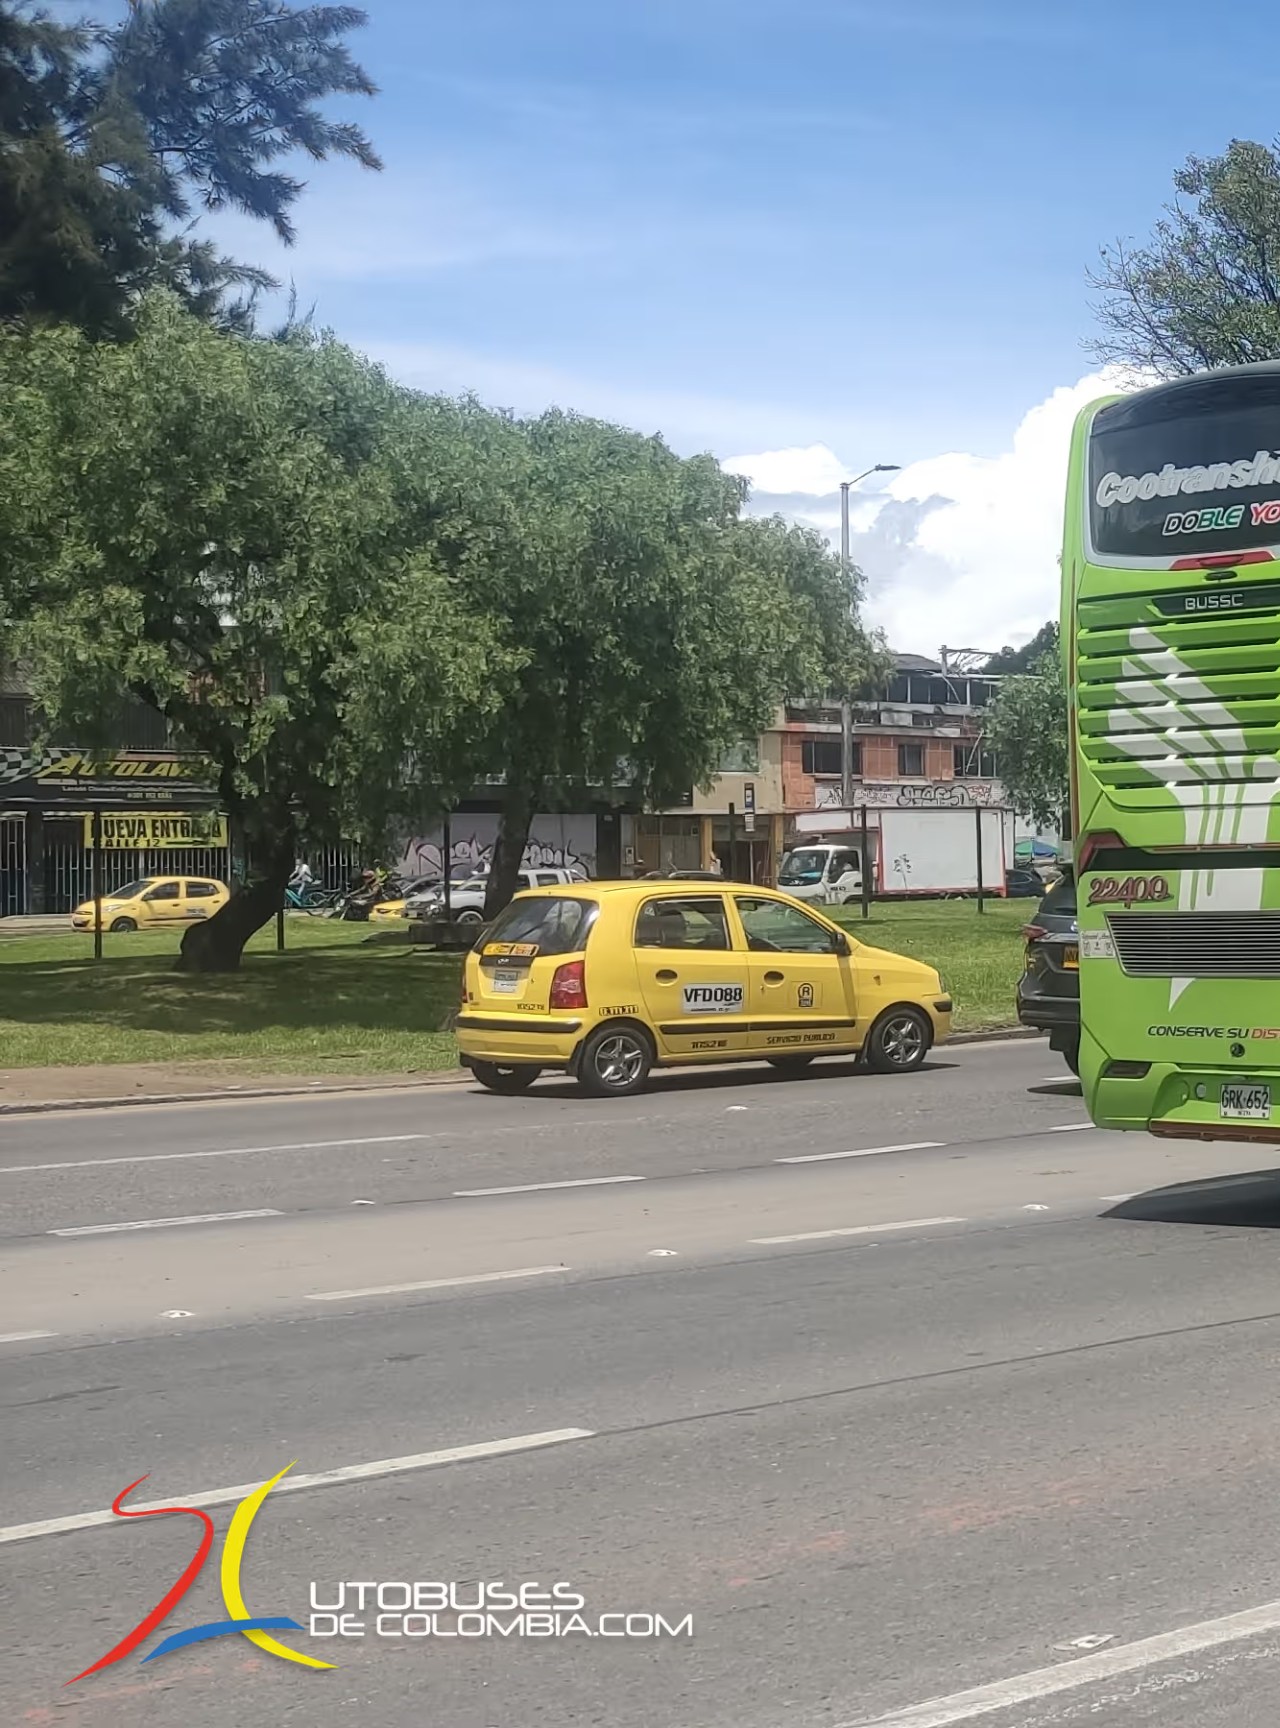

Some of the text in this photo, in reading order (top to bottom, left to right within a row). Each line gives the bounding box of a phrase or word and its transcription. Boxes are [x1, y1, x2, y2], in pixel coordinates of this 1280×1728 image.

[1162, 504, 1245, 536] DOBLE
[1185, 593, 1244, 611] BUSSC
[683, 987, 742, 1003] VFD088
[1147, 1025, 1223, 1038] CONSERVE
[1226, 1028, 1249, 1039] SU
